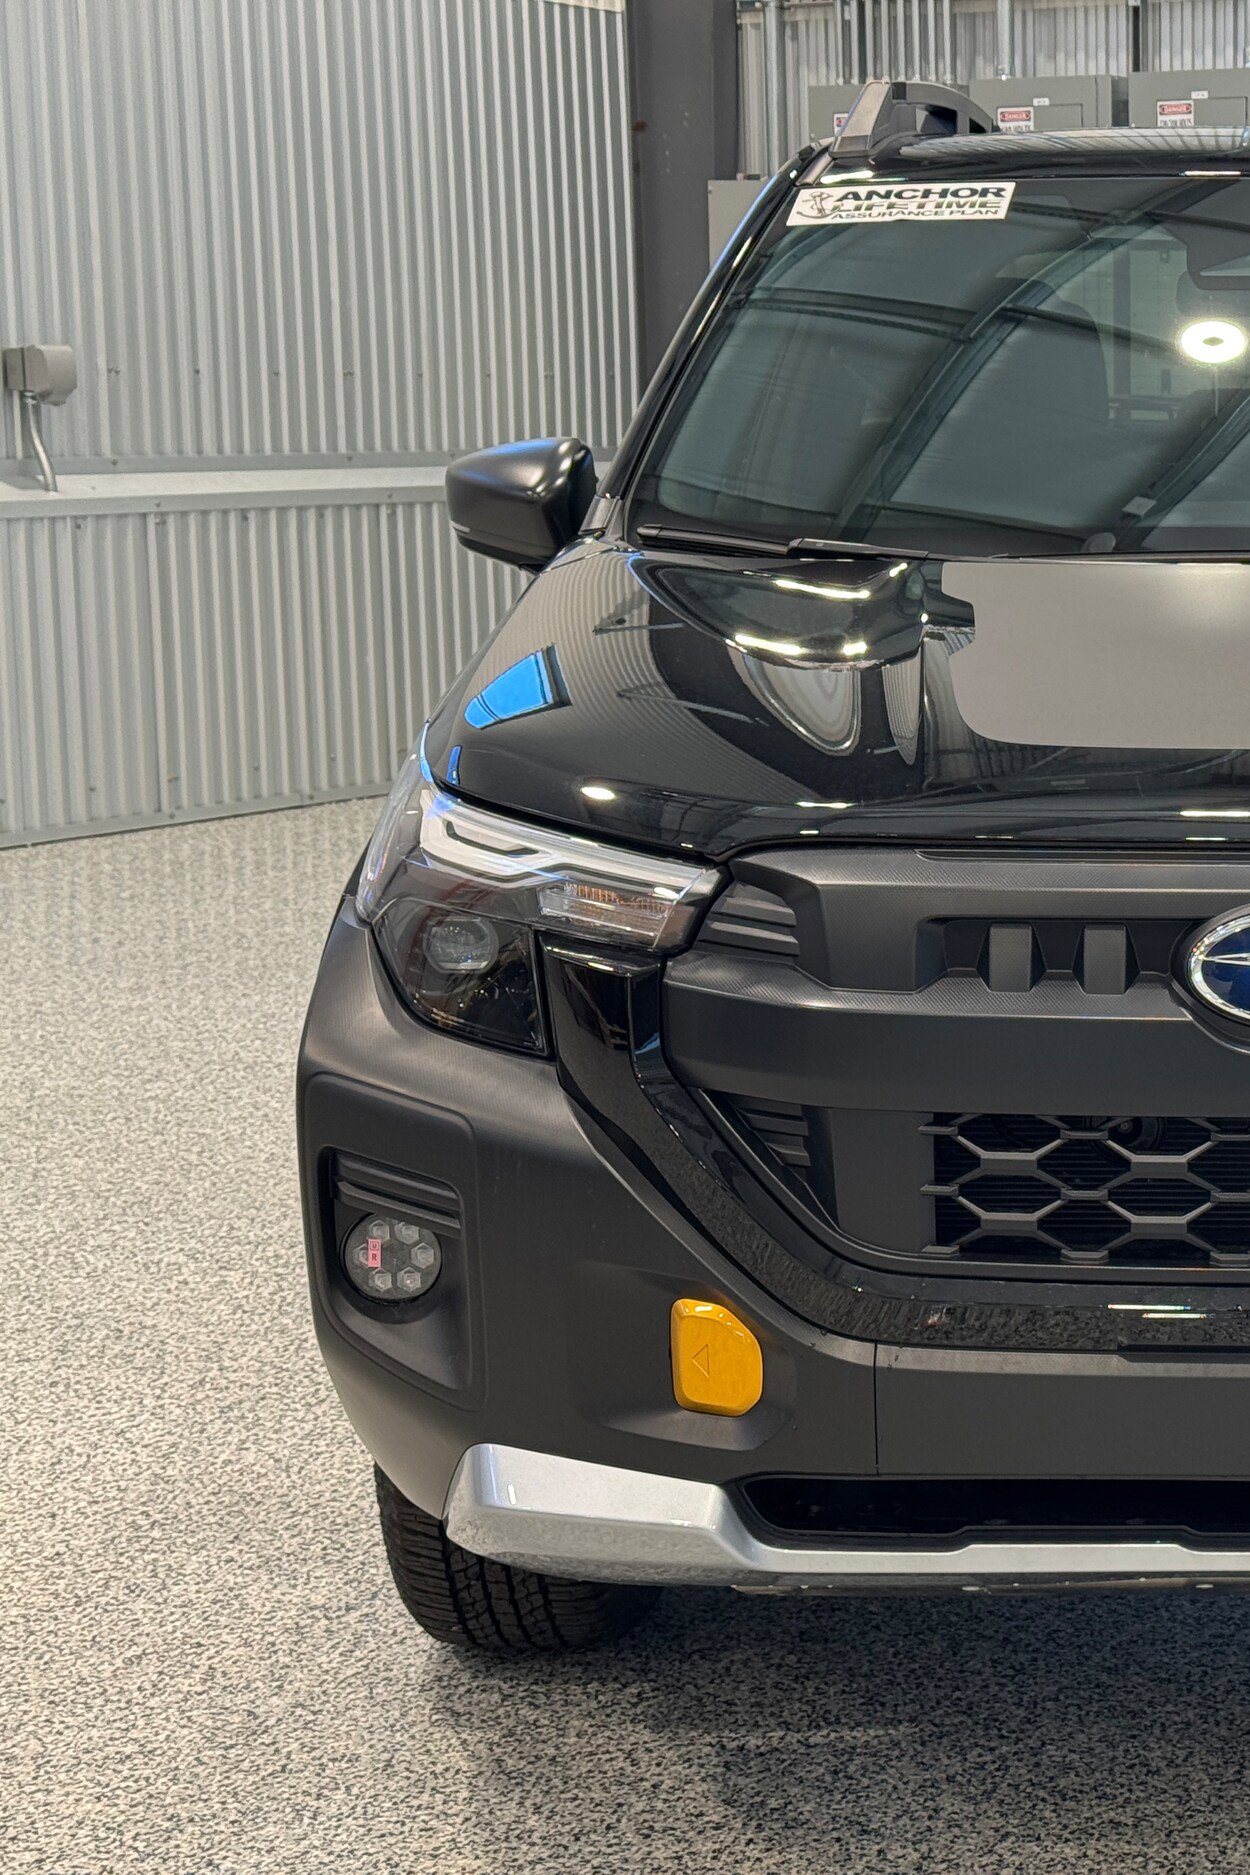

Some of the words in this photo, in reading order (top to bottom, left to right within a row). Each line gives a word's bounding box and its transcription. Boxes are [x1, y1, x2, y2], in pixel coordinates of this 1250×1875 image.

[833, 187, 1006, 202] ANCHOR
[830, 199, 1002, 213] LIFETIME
[831, 209, 944, 219] ASSURANCE
[949, 209, 999, 217] PLAN
